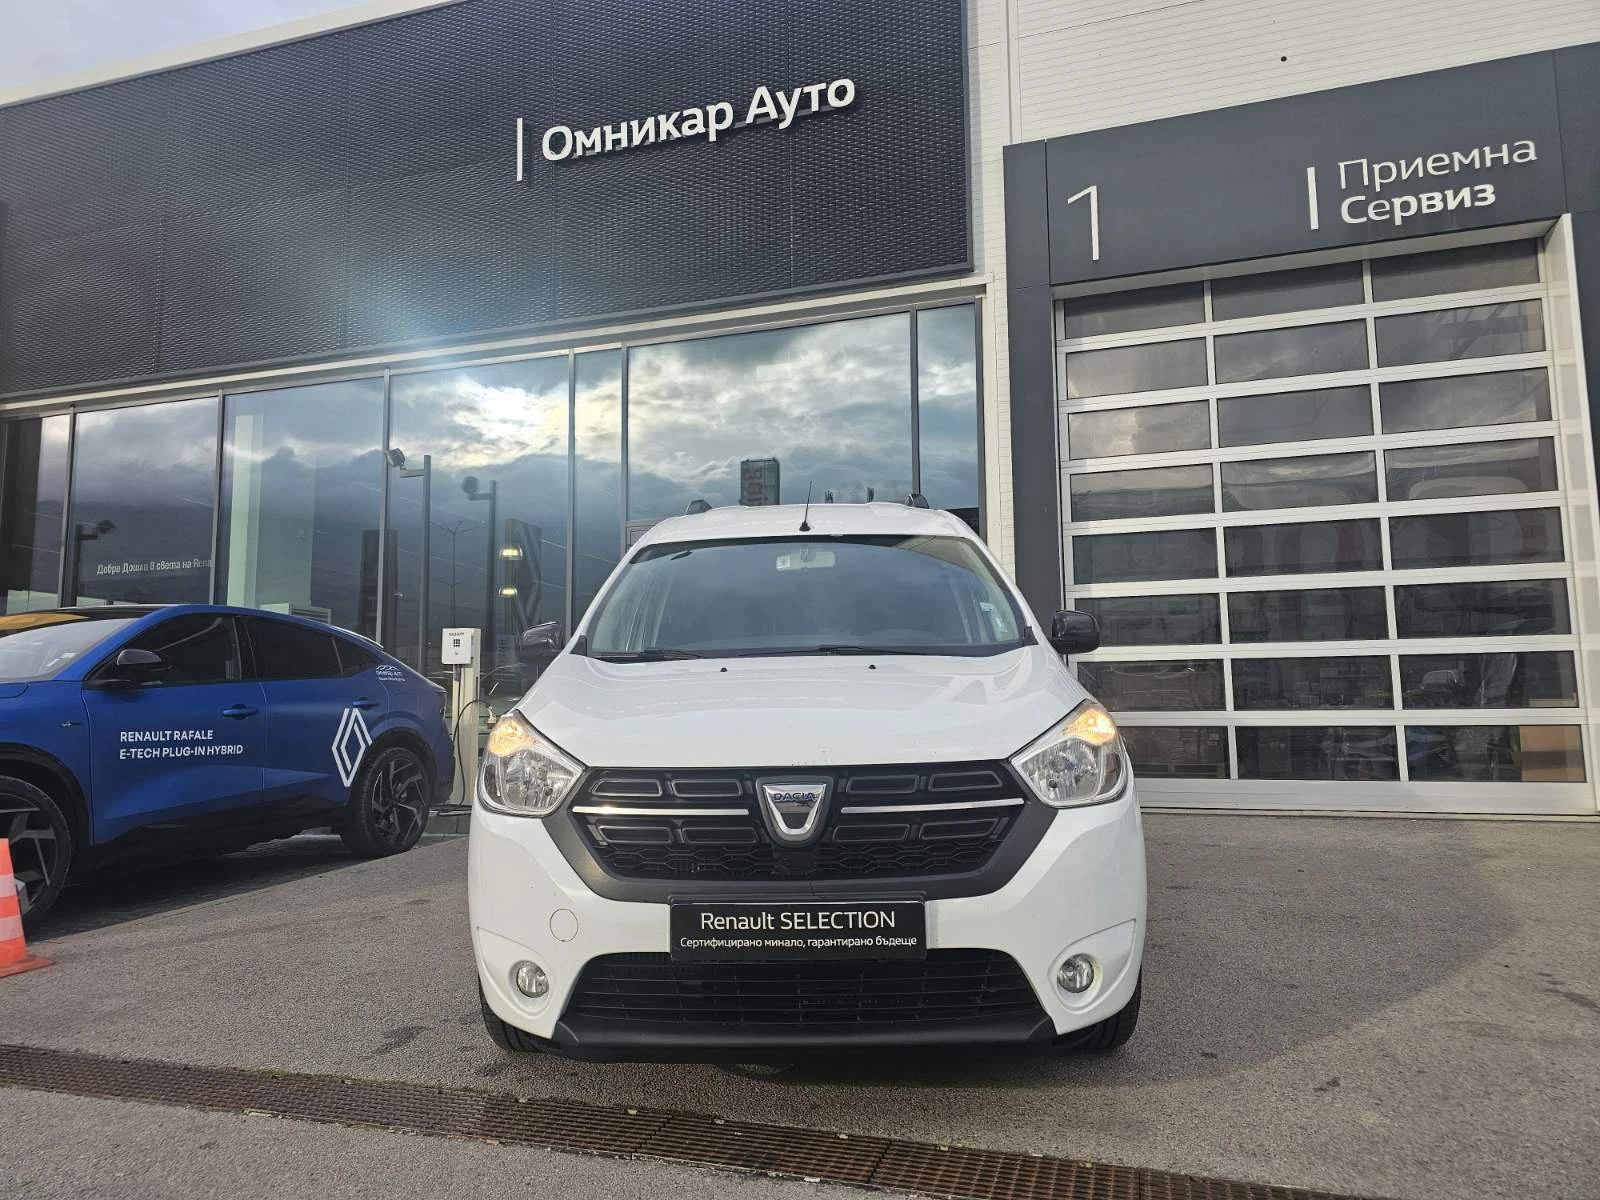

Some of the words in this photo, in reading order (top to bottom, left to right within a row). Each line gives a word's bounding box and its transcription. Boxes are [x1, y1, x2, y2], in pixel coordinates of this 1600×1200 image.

[541, 101, 734, 161] Омникар
[745, 78, 856, 129] Ауто
[1338, 139, 1537, 191] Приемна
[1341, 183, 1496, 226] Сервиз
[1066, 184, 1100, 261] 1
[120, 731, 172, 742] RENAULT
[173, 730, 214, 740] RAFALE
[119, 748, 160, 759] E-TECH
[162, 746, 205, 758] PLUG-IN
[207, 745, 244, 755] HYBRID
[773, 792, 816, 801] DACIA
[701, 912, 775, 930] Renault
[780, 911, 896, 930] SELECTION
[680, 937, 762, 949] Сертифицирано
[765, 939, 806, 948] минало,
[808, 938, 873, 948] гарантирано
[876, 936, 917, 946] бъдеще
